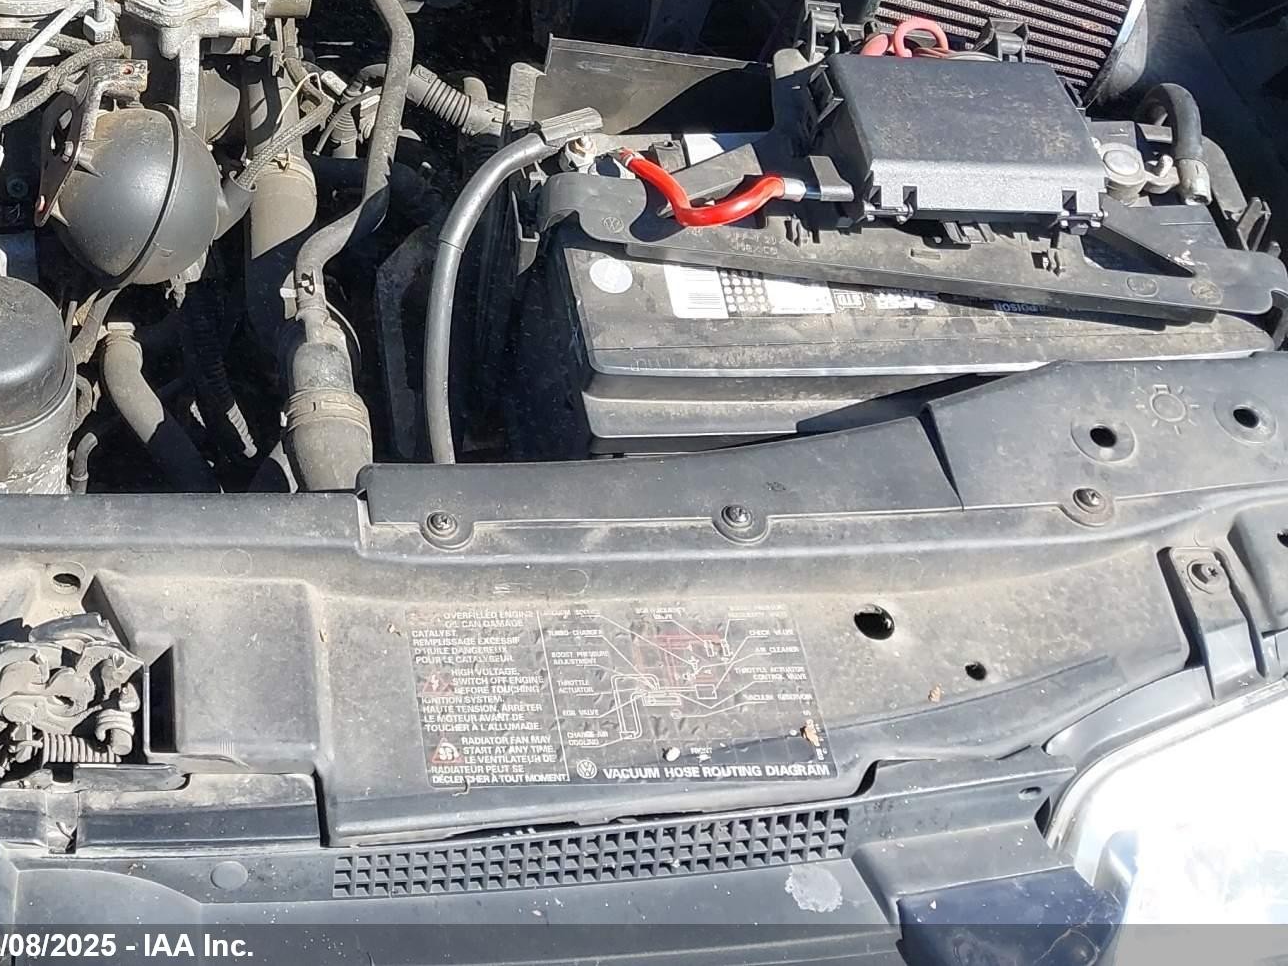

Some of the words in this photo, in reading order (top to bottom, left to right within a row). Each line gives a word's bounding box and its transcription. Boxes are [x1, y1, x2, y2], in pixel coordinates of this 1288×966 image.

[443, 610, 497, 619] OVERFILLED
[500, 610, 534, 618] ENGINE
[444, 620, 459, 628] OIL
[462, 619, 482, 627] CAN
[483, 618, 524, 627] DAMAGE
[413, 637, 475, 646] REMPLISSAGE
[477, 636, 520, 645] EXCESSIF
[452, 646, 507, 655] DANGEREUX
[415, 656, 441, 665] POUR
[443, 656, 455, 665] LE
[451, 668, 473, 677] HIGH
[453, 677, 488, 685] SWITCH
[490, 676, 507, 684] OFF
[508, 676, 544, 684] ENGINE
[556, 679, 590, 687] THROTTLE
[454, 686, 489, 694] BEFORE
[491, 685, 539, 694] TOUCHING
[422, 696, 462, 704] IGNITION
[422, 705, 454, 713] HAUTE
[479, 714, 511, 722] AVANT
[424, 724, 469, 732] TOUCHER
[462, 736, 510, 745] RADIATOR
[511, 736, 529, 744] FAN
[530, 735, 551, 744] MAY
[463, 746, 494, 755] START
[495, 746, 506, 754] AT
[508, 745, 529, 754] ANY
[464, 756, 476, 764] LE
[476, 755, 542, 764] VENTILATEUR
[543, 754, 556, 763] DE
[431, 765, 485, 774] RADIATEUR
[486, 765, 510, 773] PEUT
[512, 765, 524, 773] SE
[602, 768, 661, 779] VACUUM
[664, 767, 700, 779] HOSE
[701, 765, 762, 778] ROUTING
[765, 764, 831, 777] DIAGRAM
[499, 773, 524, 782] TOUT
